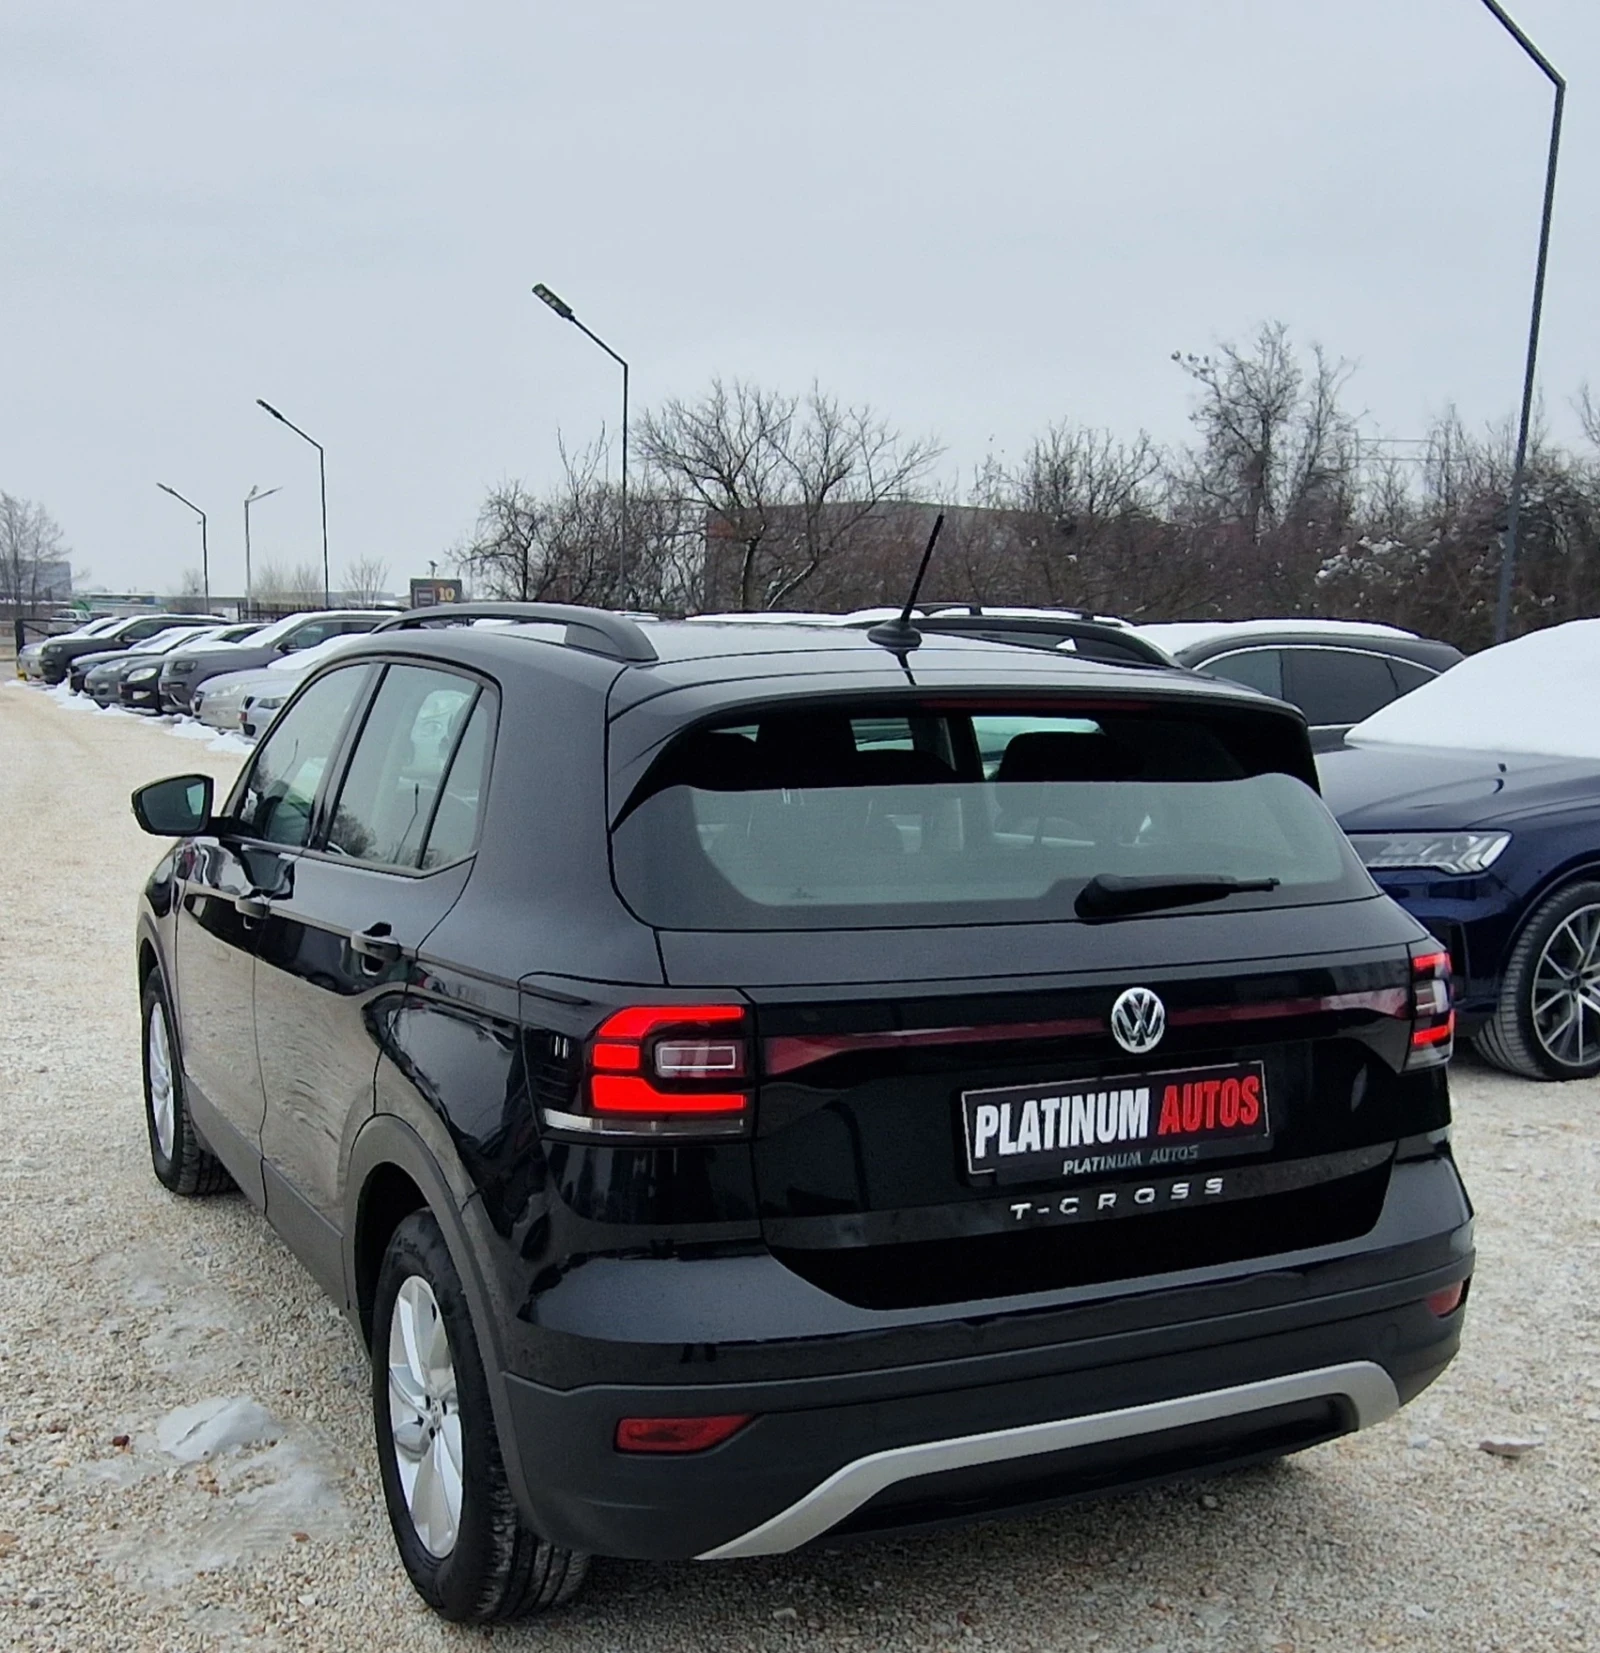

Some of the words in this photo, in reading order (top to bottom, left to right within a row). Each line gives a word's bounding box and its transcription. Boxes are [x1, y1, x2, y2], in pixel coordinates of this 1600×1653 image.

[974, 1088, 1150, 1159] PLATINUM
[1158, 1076, 1260, 1135] AUTOS
[1062, 1151, 1142, 1175] PLATINUM
[1150, 1145, 1198, 1164] AUTOS
[1010, 1178, 1223, 1220] T-CROSS
